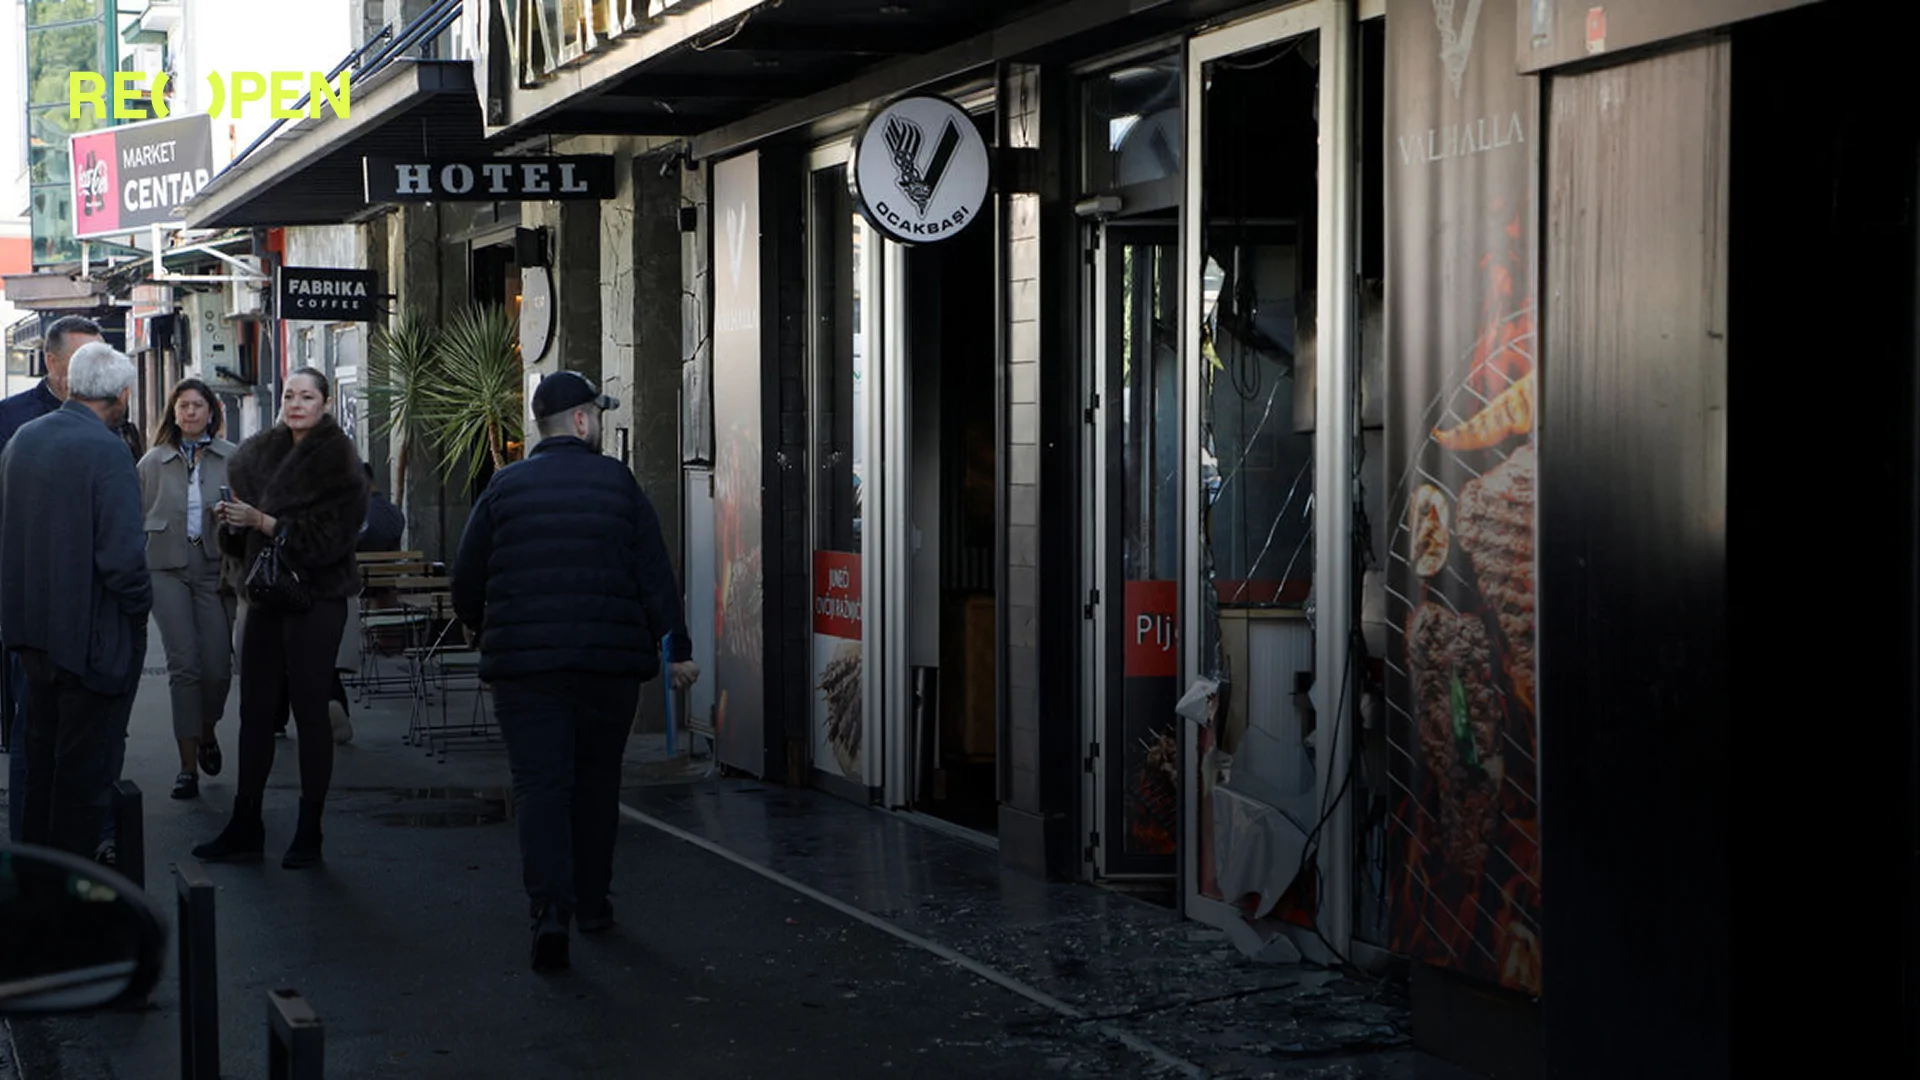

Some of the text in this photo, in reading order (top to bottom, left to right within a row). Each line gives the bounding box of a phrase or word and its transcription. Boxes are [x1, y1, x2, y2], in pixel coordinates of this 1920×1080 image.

[1398, 111, 1526, 165] VALHALLA
[122, 141, 177, 168] MARKET
[395, 163, 588, 194] HOTEL
[288, 279, 367, 297] FABRIKA
[296, 298, 360, 310] COFFEE
